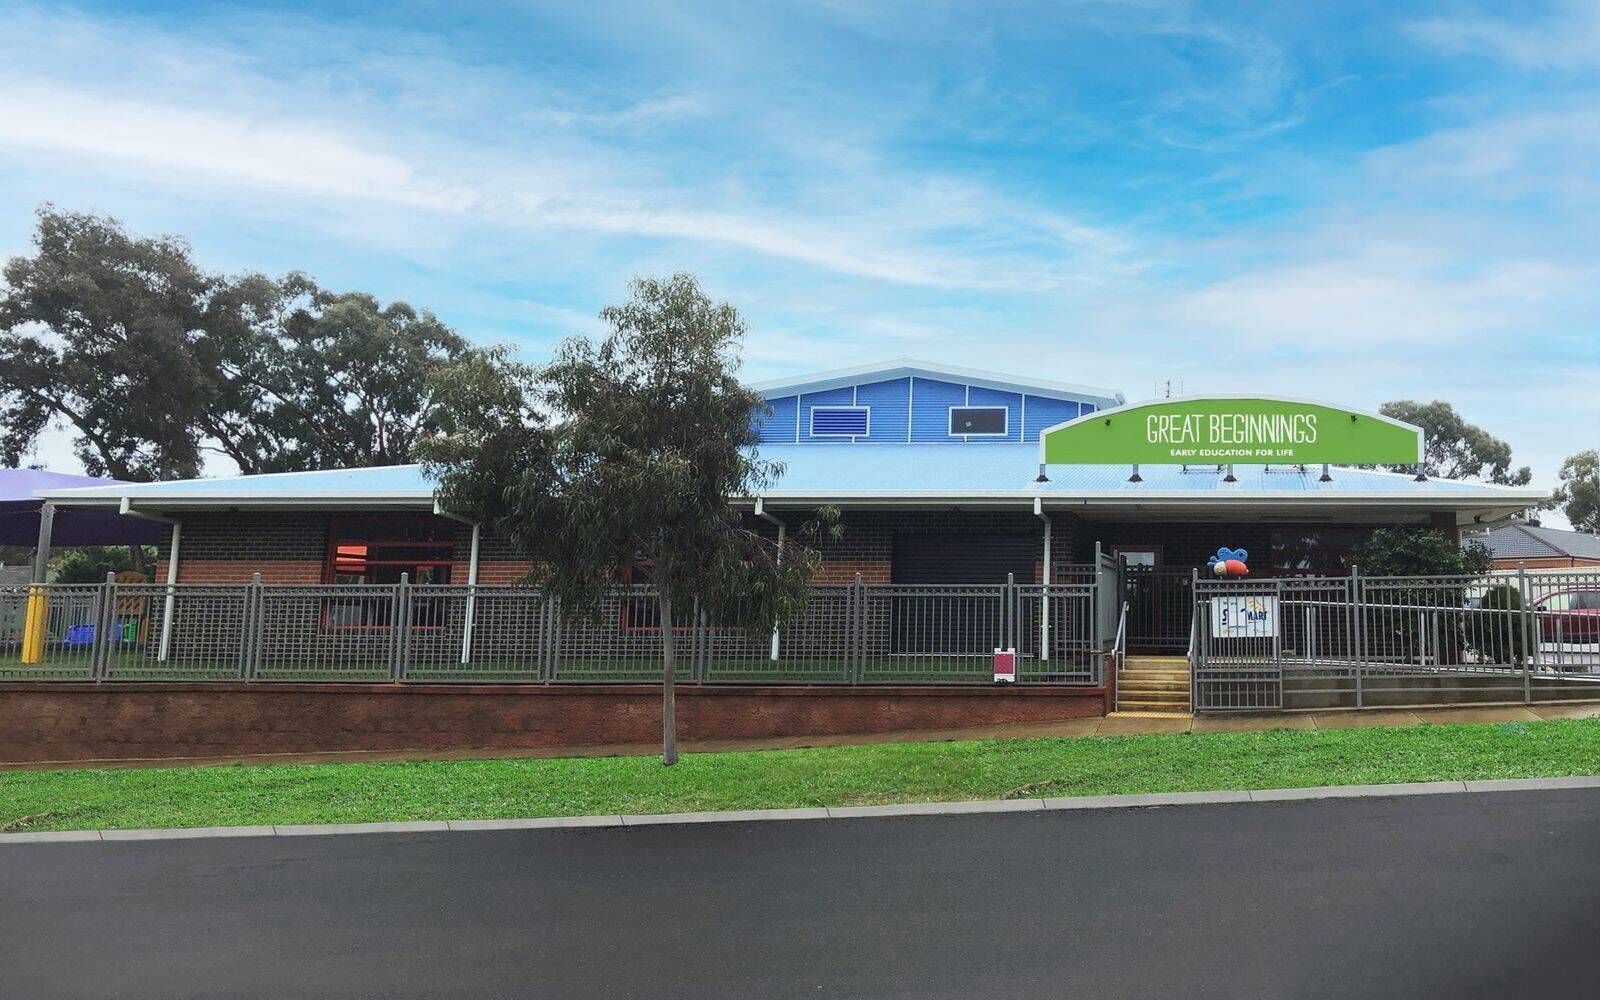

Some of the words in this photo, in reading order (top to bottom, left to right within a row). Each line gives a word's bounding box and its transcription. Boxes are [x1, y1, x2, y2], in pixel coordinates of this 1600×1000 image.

[1146, 414, 1205, 444] GREAT
[1209, 414, 1317, 444] BEGINNINGS
[1170, 449, 1197, 457] EARLY
[1199, 449, 1253, 457] EDUCATION
[1255, 449, 1274, 457] FOR
[1276, 449, 1294, 457] LIFE
